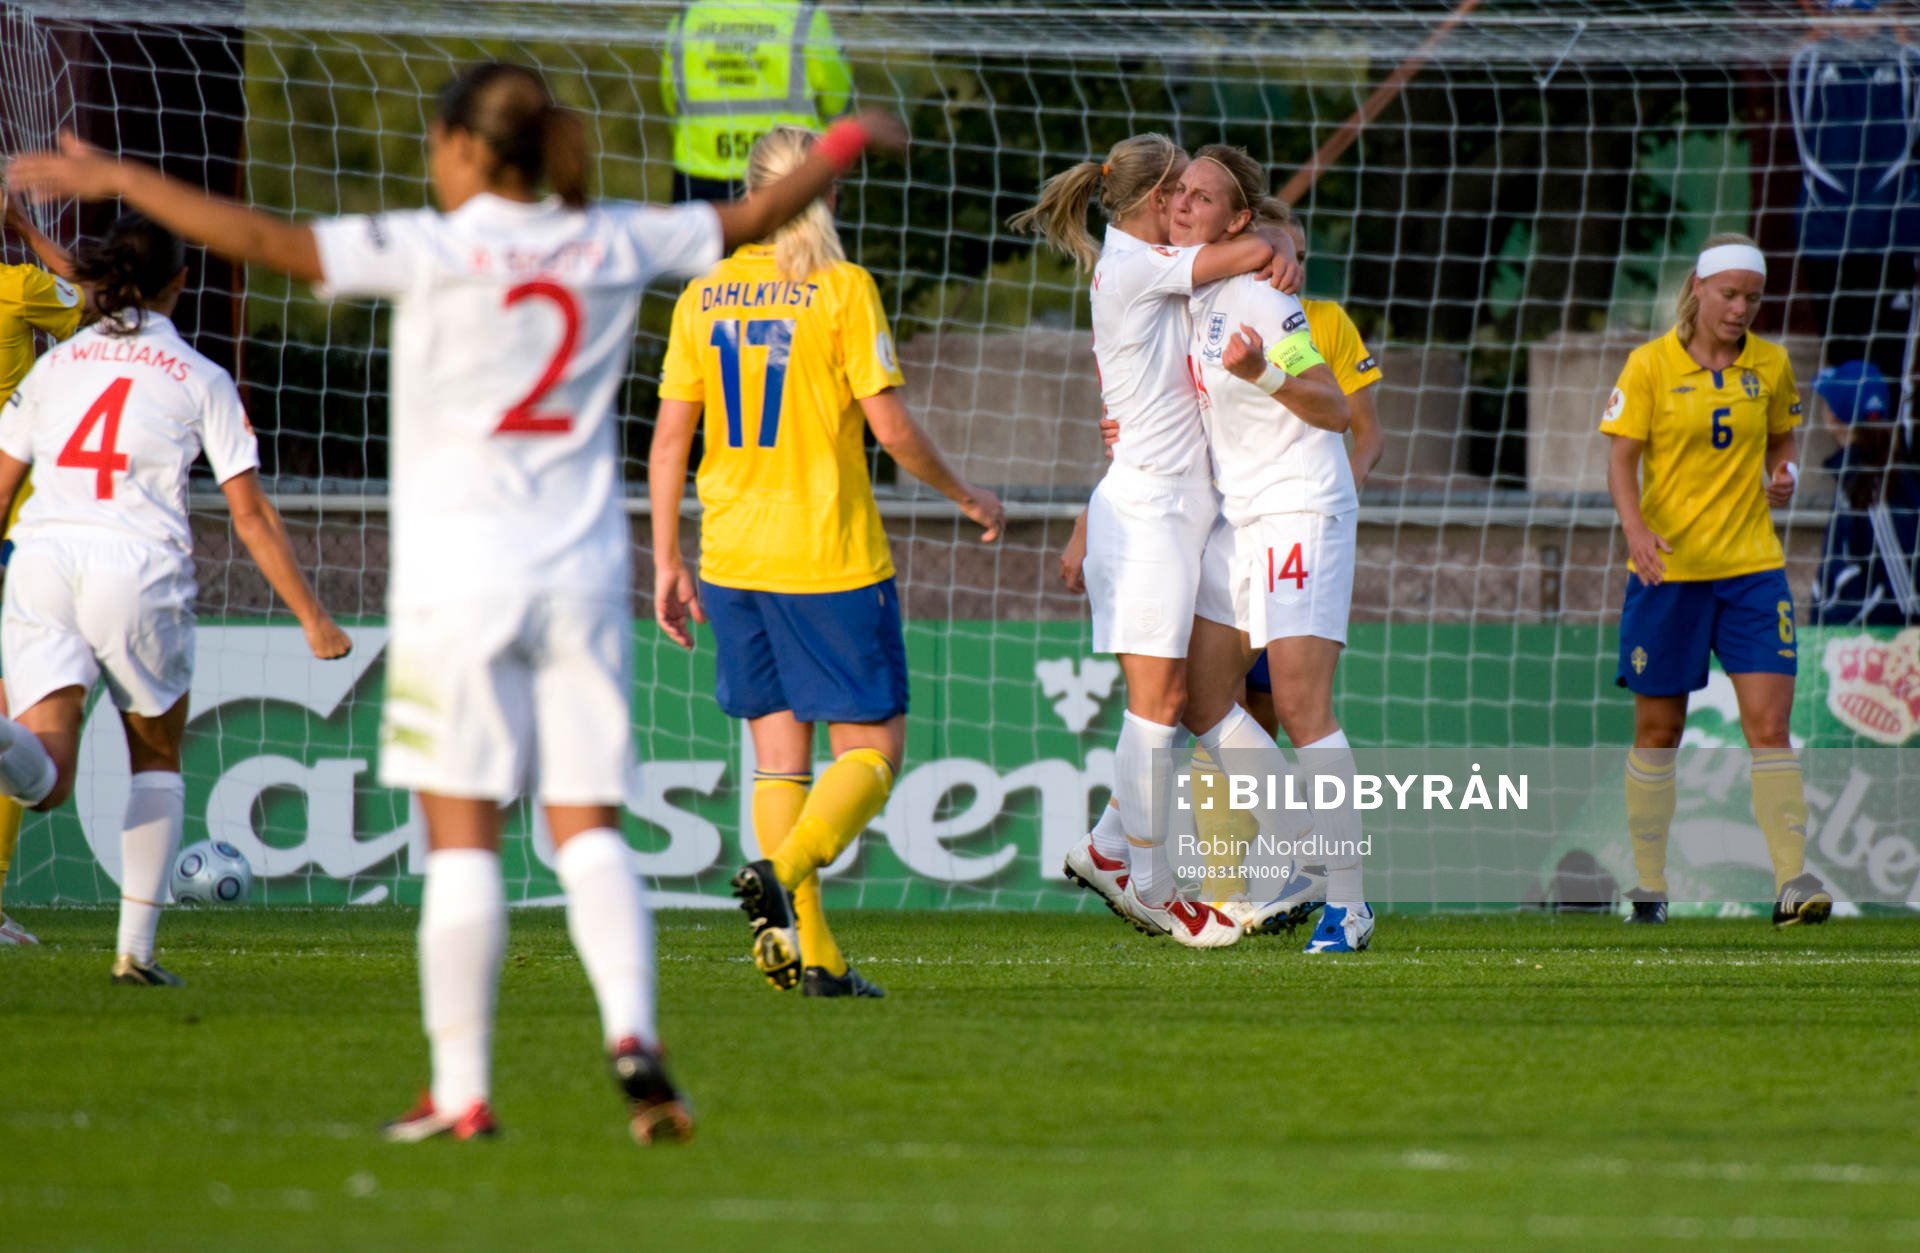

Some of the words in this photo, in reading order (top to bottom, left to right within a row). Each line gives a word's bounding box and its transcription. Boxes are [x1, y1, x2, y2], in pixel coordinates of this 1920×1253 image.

[702, 281, 818, 312] DAHLKVIST
[71, 343, 192, 381] WILLIAMS
[493, 280, 581, 435] 2
[710, 319, 796, 447] 17
[57, 376, 133, 500] 4
[1711, 407, 1734, 449] 6
[1267, 542, 1309, 593] 14
[1777, 600, 1793, 643] 6
